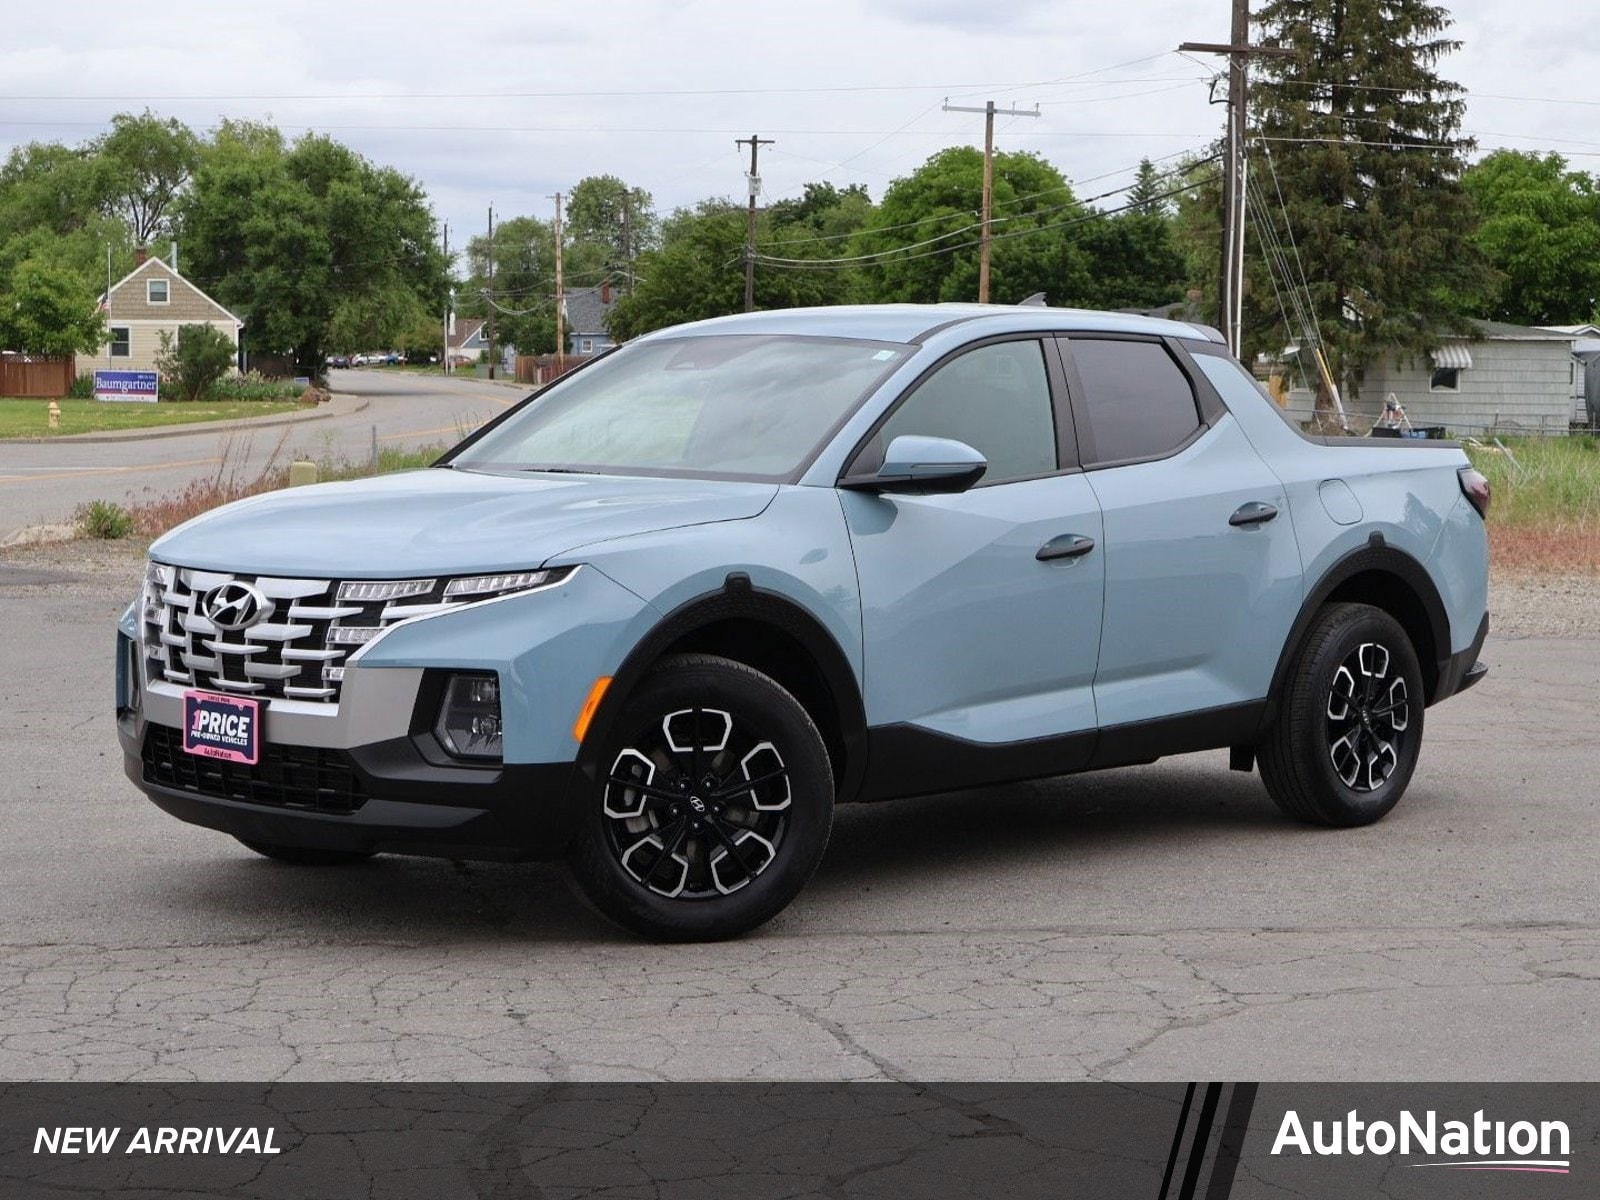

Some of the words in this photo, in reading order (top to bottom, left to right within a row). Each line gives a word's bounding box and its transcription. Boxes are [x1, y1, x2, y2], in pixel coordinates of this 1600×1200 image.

[96, 377, 156, 393] Baumgartner
[191, 730, 221, 741] PRE-OWNED
[221, 735, 248, 746] VEHICLES
